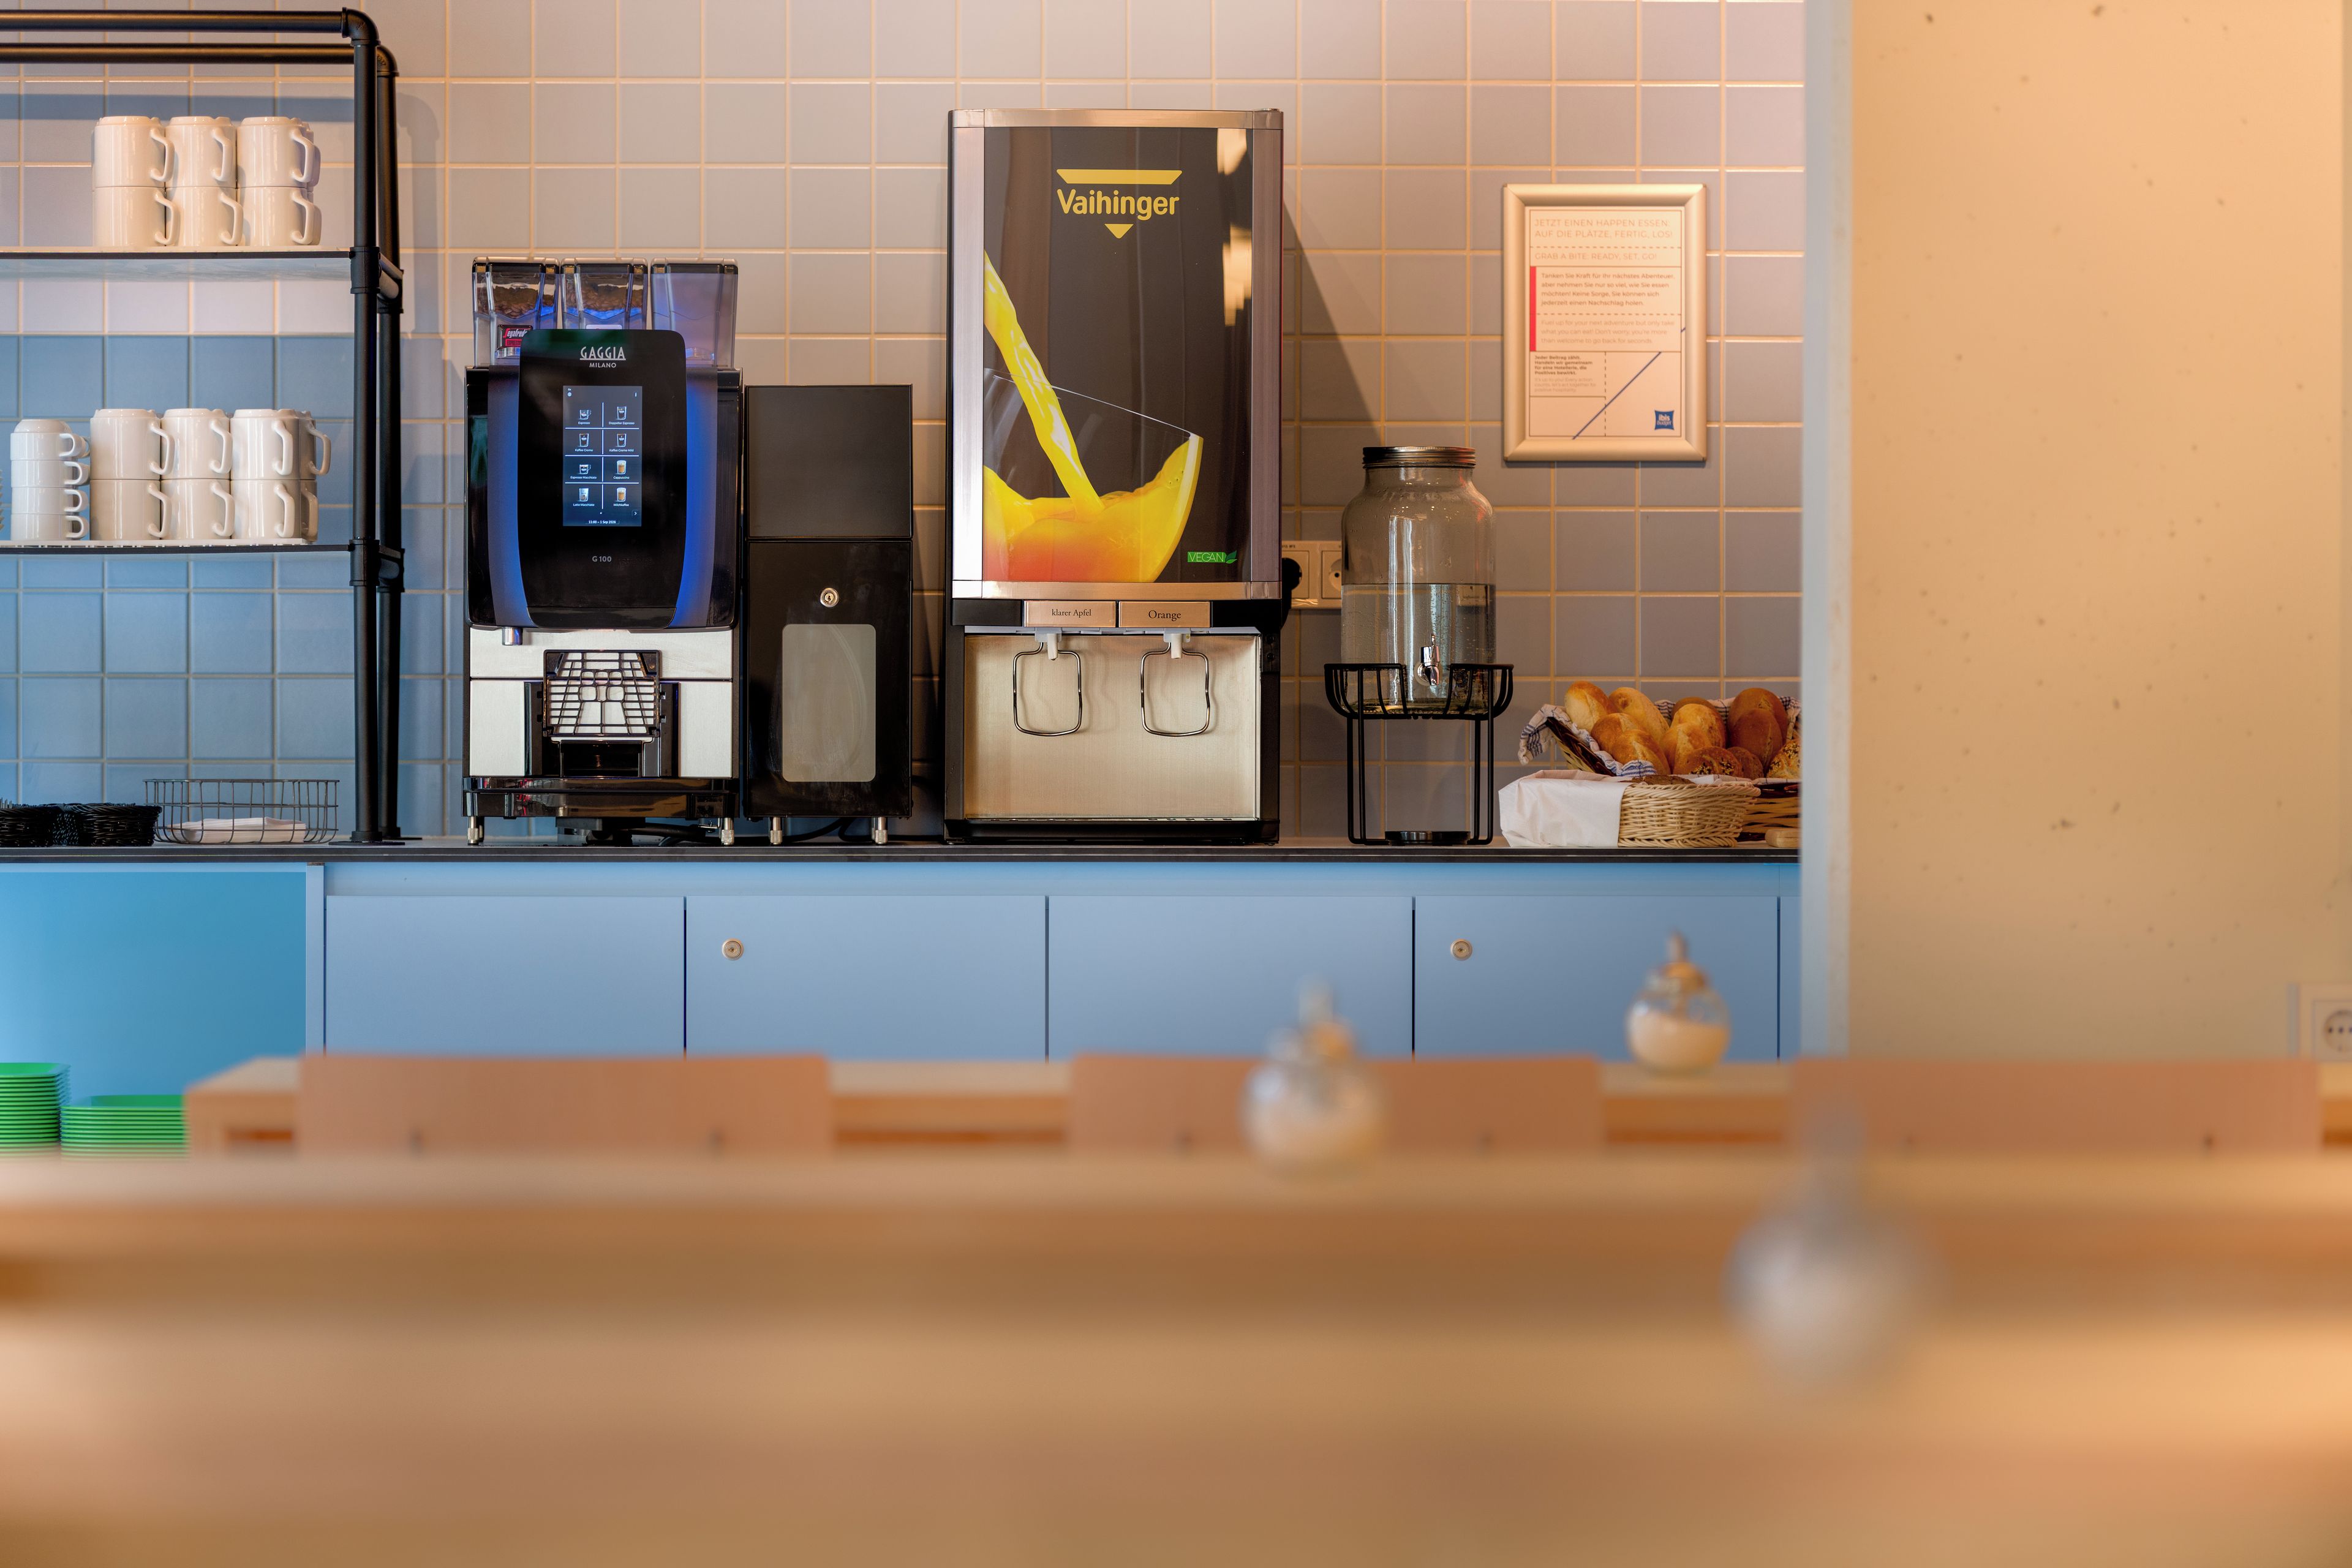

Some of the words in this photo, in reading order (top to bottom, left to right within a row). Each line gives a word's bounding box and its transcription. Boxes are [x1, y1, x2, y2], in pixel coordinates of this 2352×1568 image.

[1057, 189, 1180, 221] Vaihinger
[1575, 229, 1611, 239] PLÄTZE,
[1615, 230, 1649, 239] FERTIG,
[1592, 252, 1621, 261] READY,
[503, 328, 527, 338] Segafred
[580, 346, 626, 360] GAGGIA
[1188, 552, 1224, 562] VEGAN
[1073, 608, 1091, 617] Apfel
[1148, 609, 1182, 622] Orange
